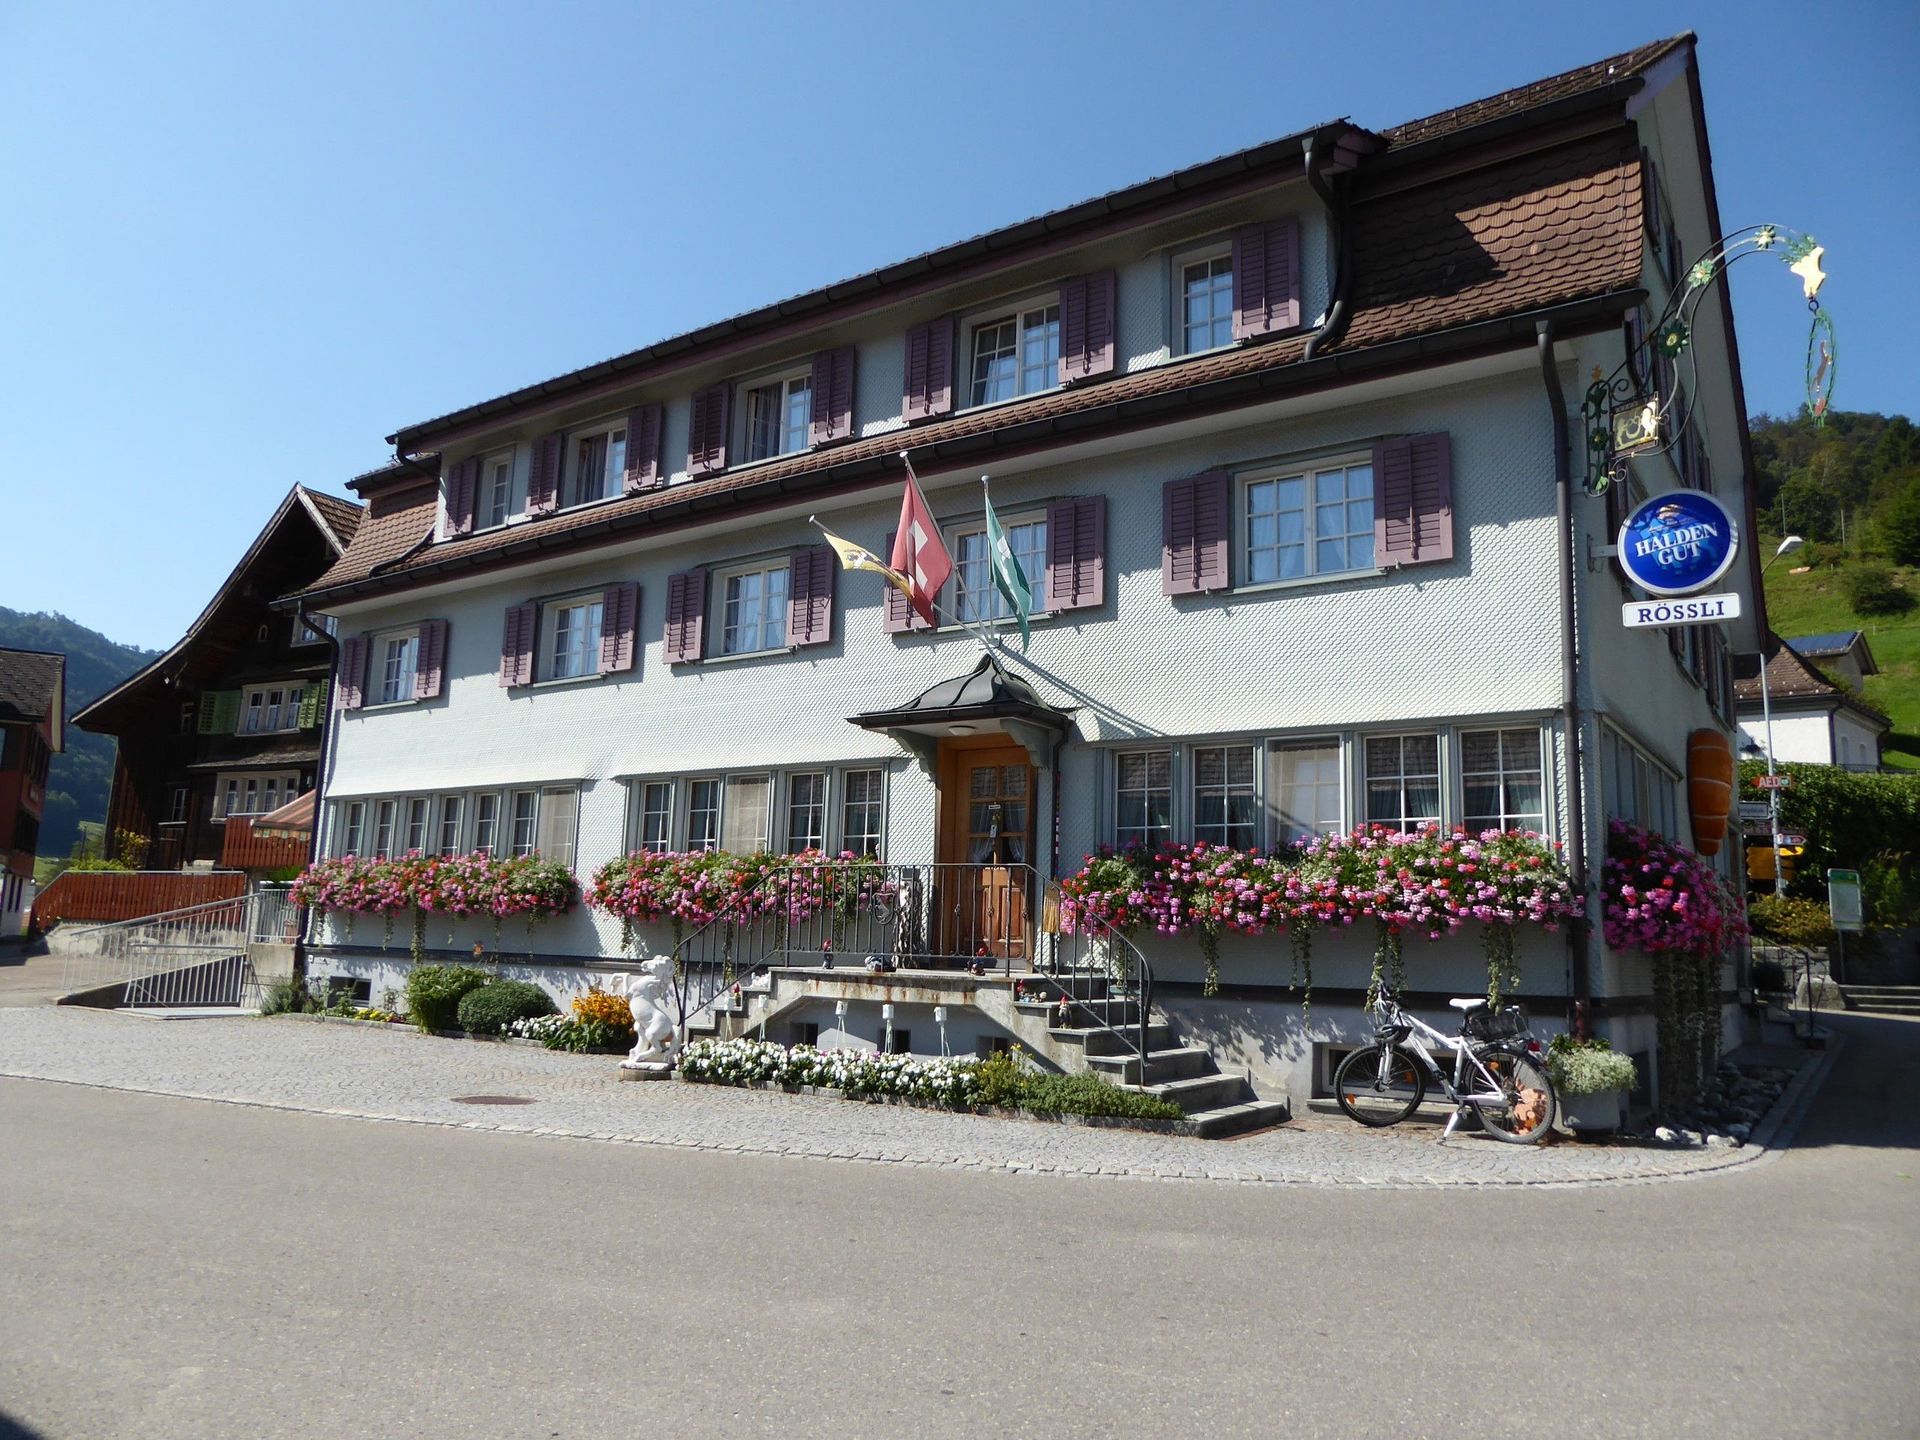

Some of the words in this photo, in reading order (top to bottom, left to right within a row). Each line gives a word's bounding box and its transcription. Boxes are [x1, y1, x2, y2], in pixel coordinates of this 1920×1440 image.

[1635, 522, 1718, 557] HALDEN
[1658, 541, 1701, 565] GUT
[1638, 600, 1725, 623] RÖSSLI
[1758, 776, 1780, 788] AED
